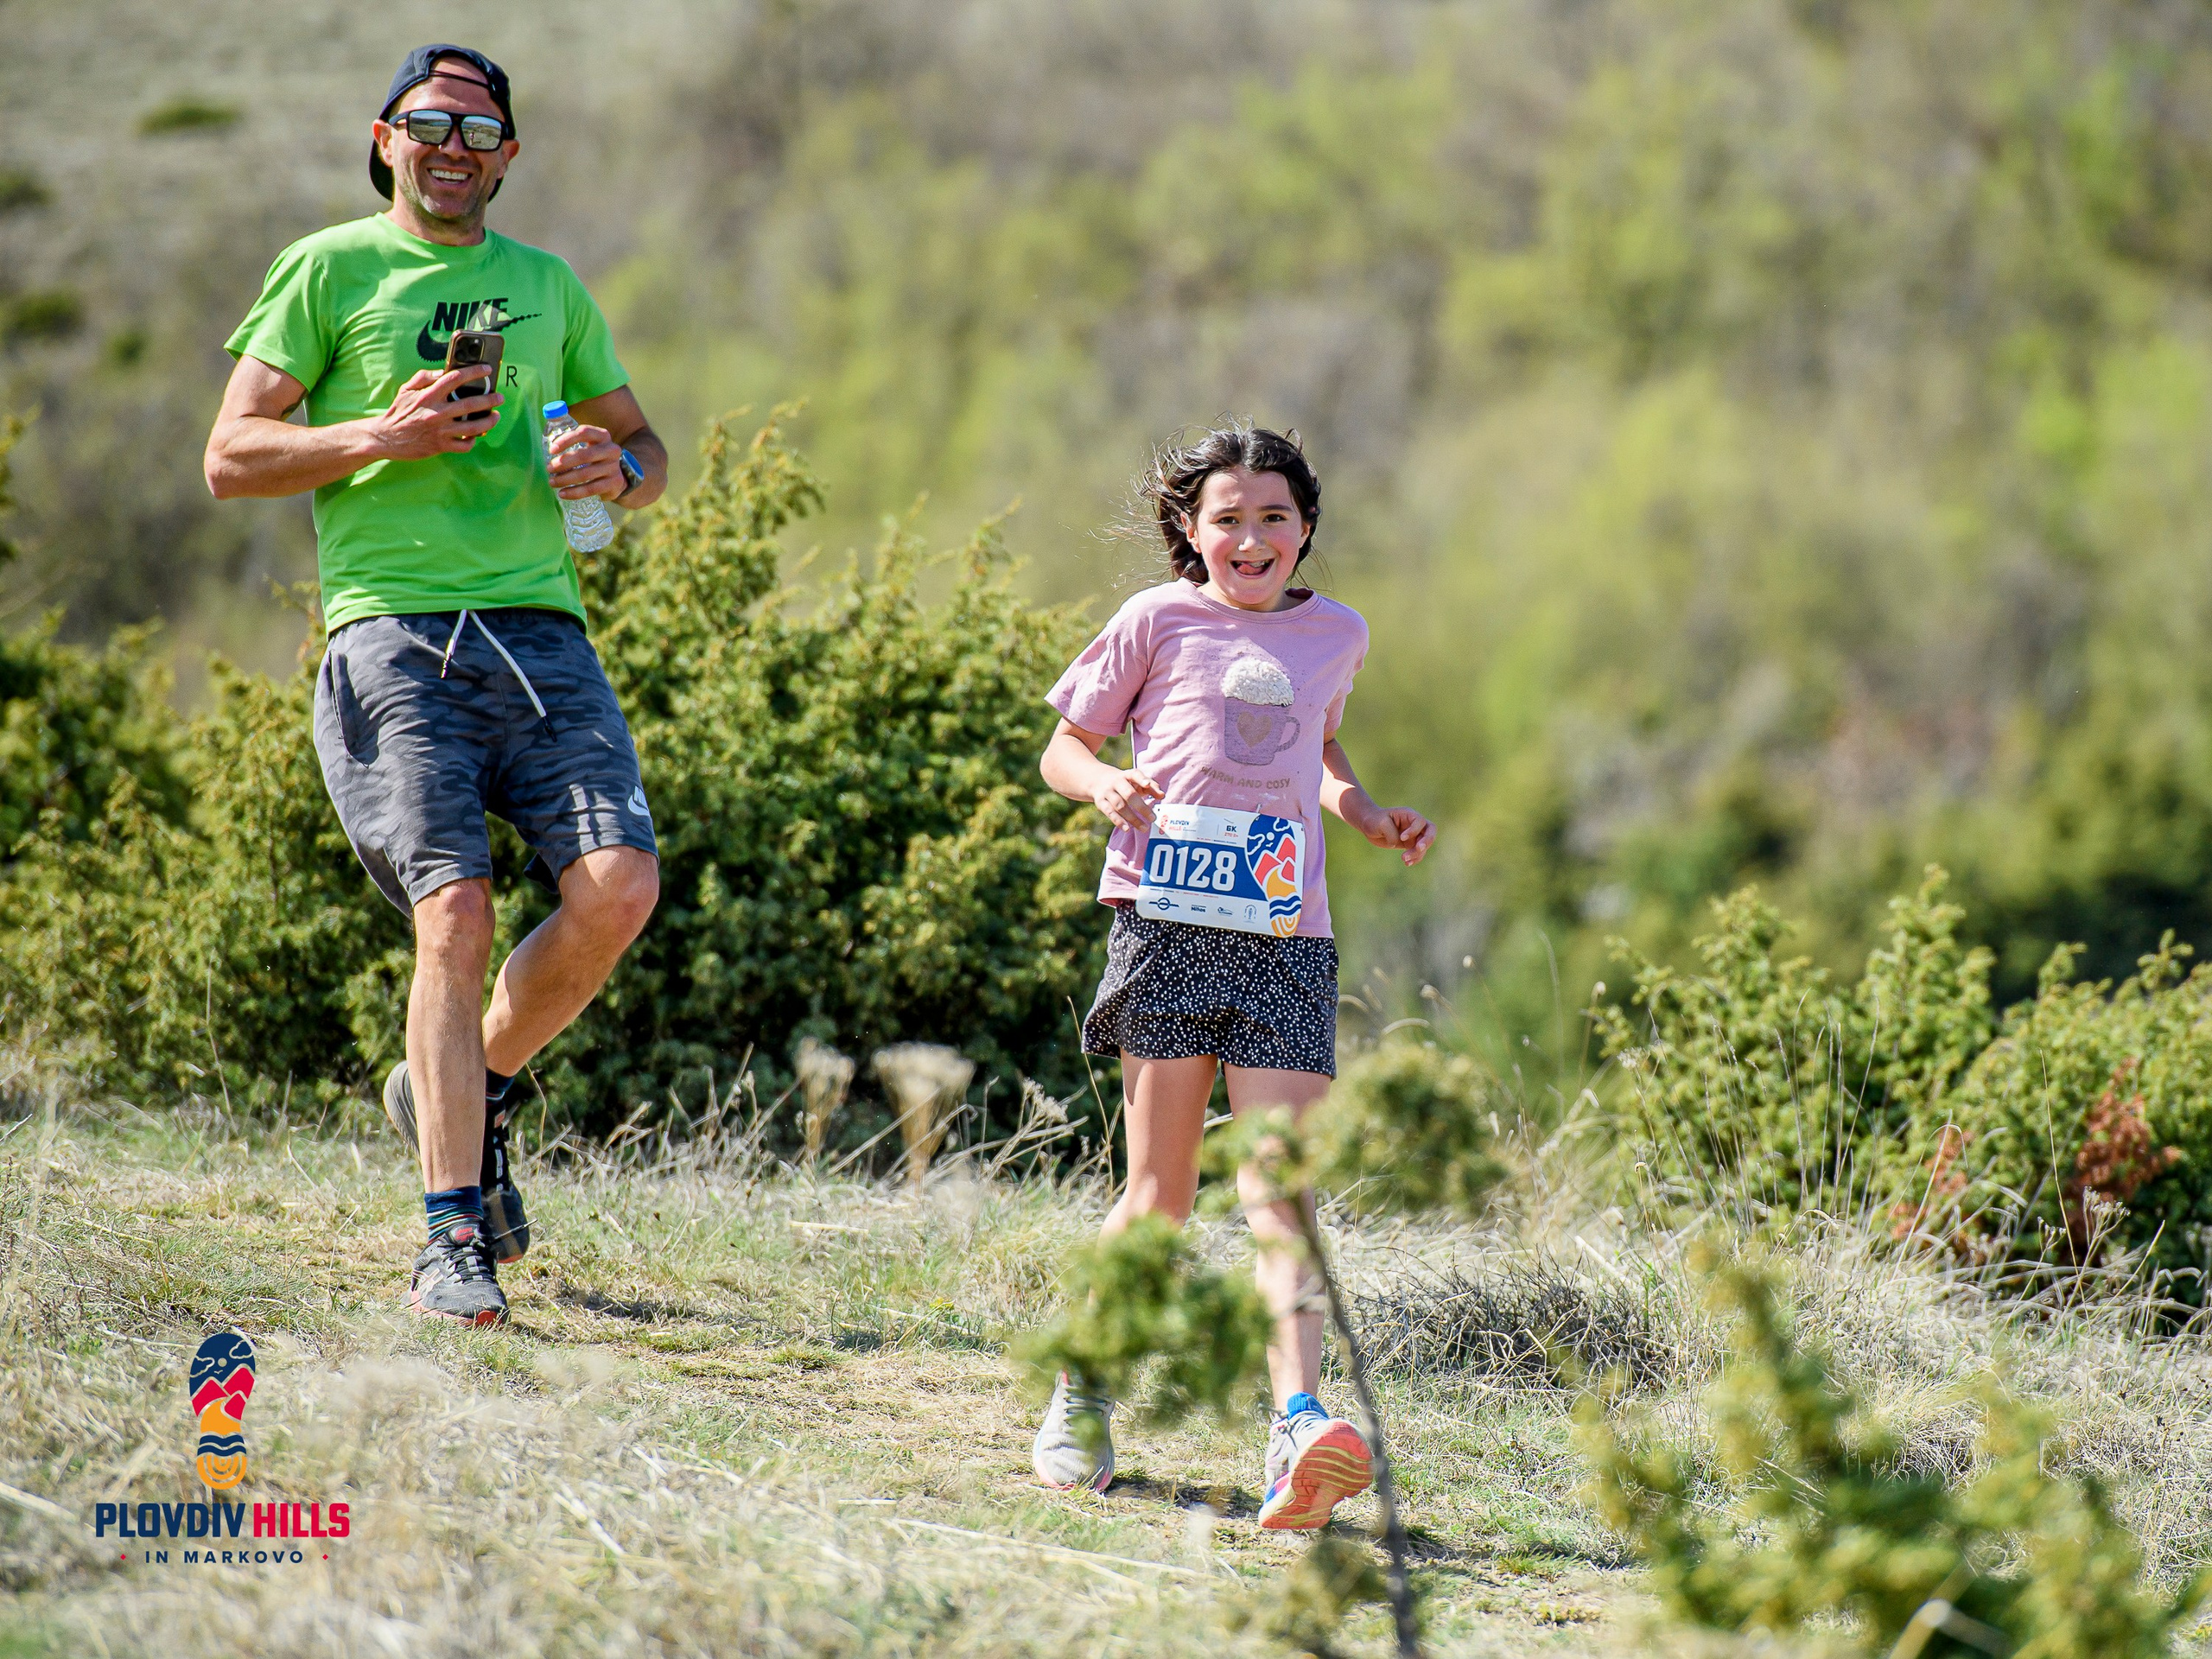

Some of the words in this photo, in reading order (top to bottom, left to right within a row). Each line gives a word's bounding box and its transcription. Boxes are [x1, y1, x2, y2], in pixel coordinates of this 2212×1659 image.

[432, 298, 509, 332] NIKE
[1200, 766, 1234, 785] WARM
[1237, 779, 1262, 788] AND
[1266, 779, 1290, 789] COSY
[1149, 844, 1237, 892] 0128
